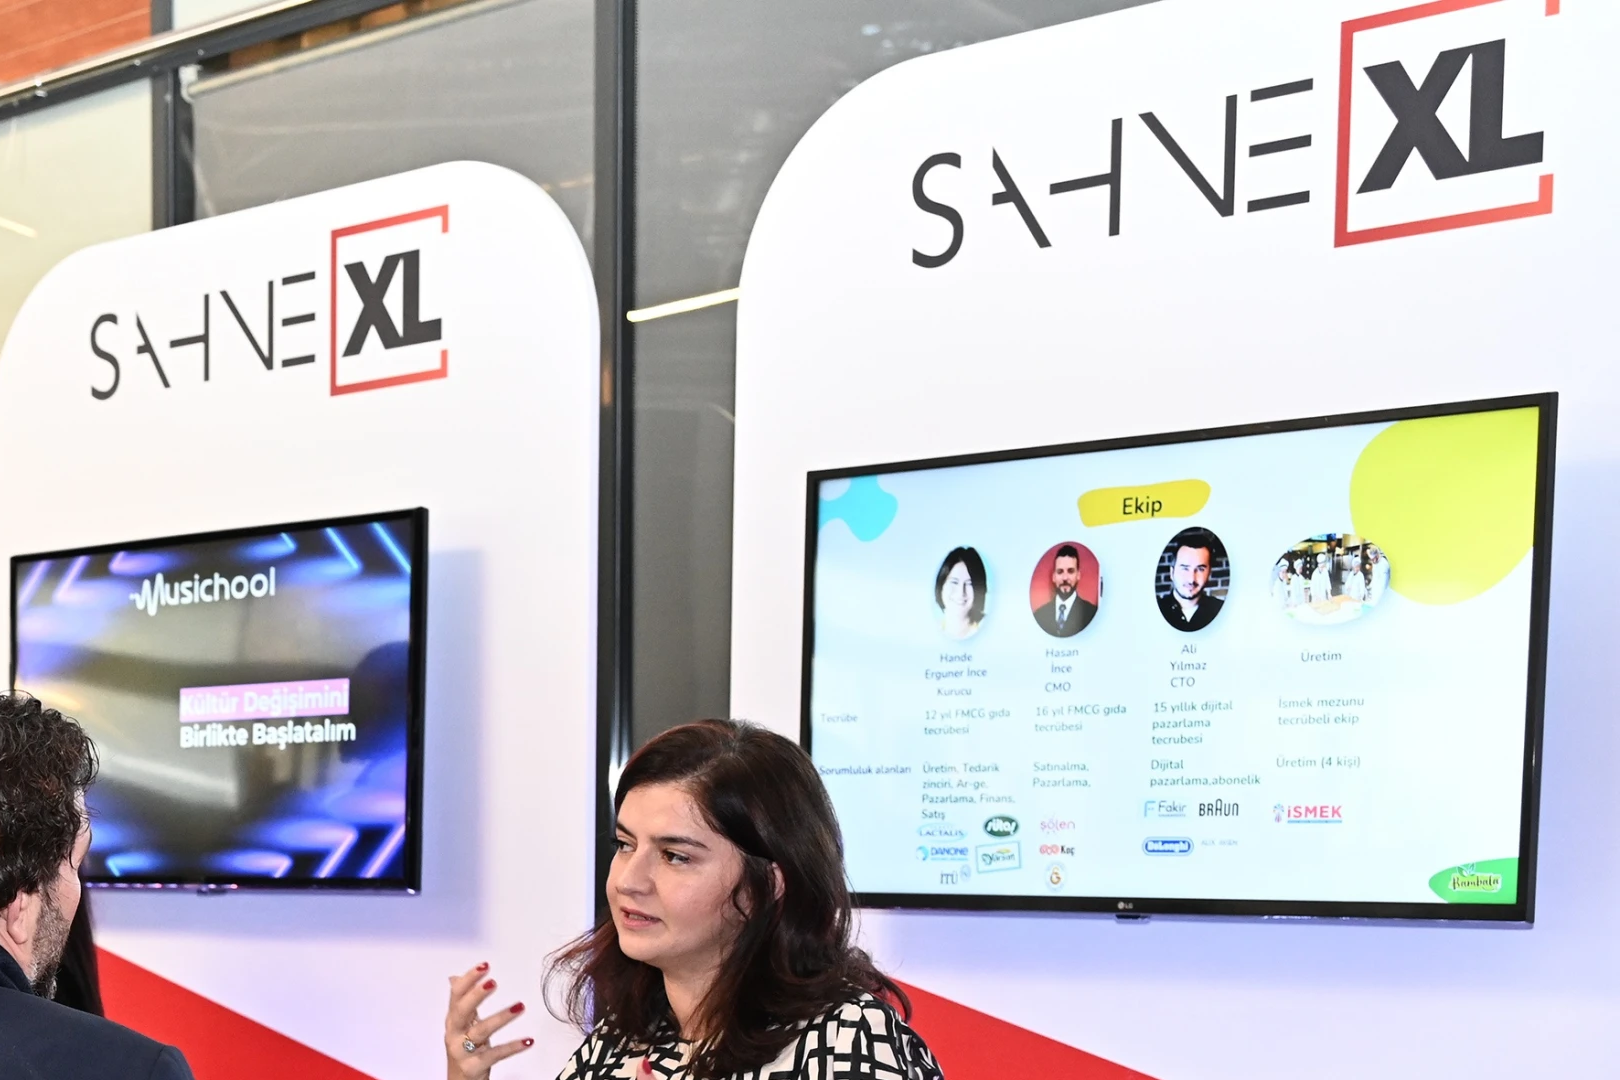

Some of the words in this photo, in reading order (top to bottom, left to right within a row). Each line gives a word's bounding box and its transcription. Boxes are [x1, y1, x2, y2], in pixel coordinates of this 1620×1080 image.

[912, 78, 1313, 268] SAHNE
[1356, 38, 1544, 194] XL
[90, 271, 315, 400] SAHNE
[342, 249, 442, 357] XL
[1123, 496, 1163, 517] Ekip
[129, 566, 276, 616] Musichool
[1045, 648, 1079, 658] Hasan
[1181, 644, 1197, 654] Ali
[1301, 648, 1342, 662] Üretim
[940, 653, 972, 663] Hande
[967, 664, 987, 677] İnce
[1051, 662, 1072, 673] İnce
[1170, 661, 1207, 671] Yılmaz
[1045, 682, 1071, 692] CMO
[1170, 677, 1196, 688] CTO
[937, 687, 972, 696] Kurucu
[1153, 702, 1167, 713] 15
[1171, 701, 1197, 714] yıllık
[1201, 700, 1233, 713] dijital
[1317, 698, 1364, 707] mezunu
[925, 709, 937, 720] 12
[940, 709, 952, 721] yıl
[955, 708, 986, 719] FMCG
[988, 708, 1011, 720] gıda
[1036, 706, 1049, 717] 16
[1052, 706, 1064, 718] yıl
[1067, 705, 1100, 715] FMCG
[1103, 705, 1127, 717] gıda
[1152, 718, 1211, 730] pazarlama
[1278, 713, 1330, 725] tecrübeli
[1334, 713, 1360, 726] ekip
[1035, 720, 1082, 732] tecrübesi
[180, 723, 249, 749] Birlikte
[252, 718, 356, 750] Başlatalım
[963, 762, 1000, 773] Tedarik
[1150, 759, 1184, 772] Dijital
[1276, 754, 1317, 768] Üretim
[1321, 756, 1332, 769] (4
[1336, 756, 1361, 769] kişi)
[820, 765, 873, 775] Sorumluluk
[1032, 777, 1091, 788] Pazarlama,
[1198, 798, 1239, 816] BRAUN
[921, 810, 946, 820] Satış
[1060, 845, 1076, 856] Koç
